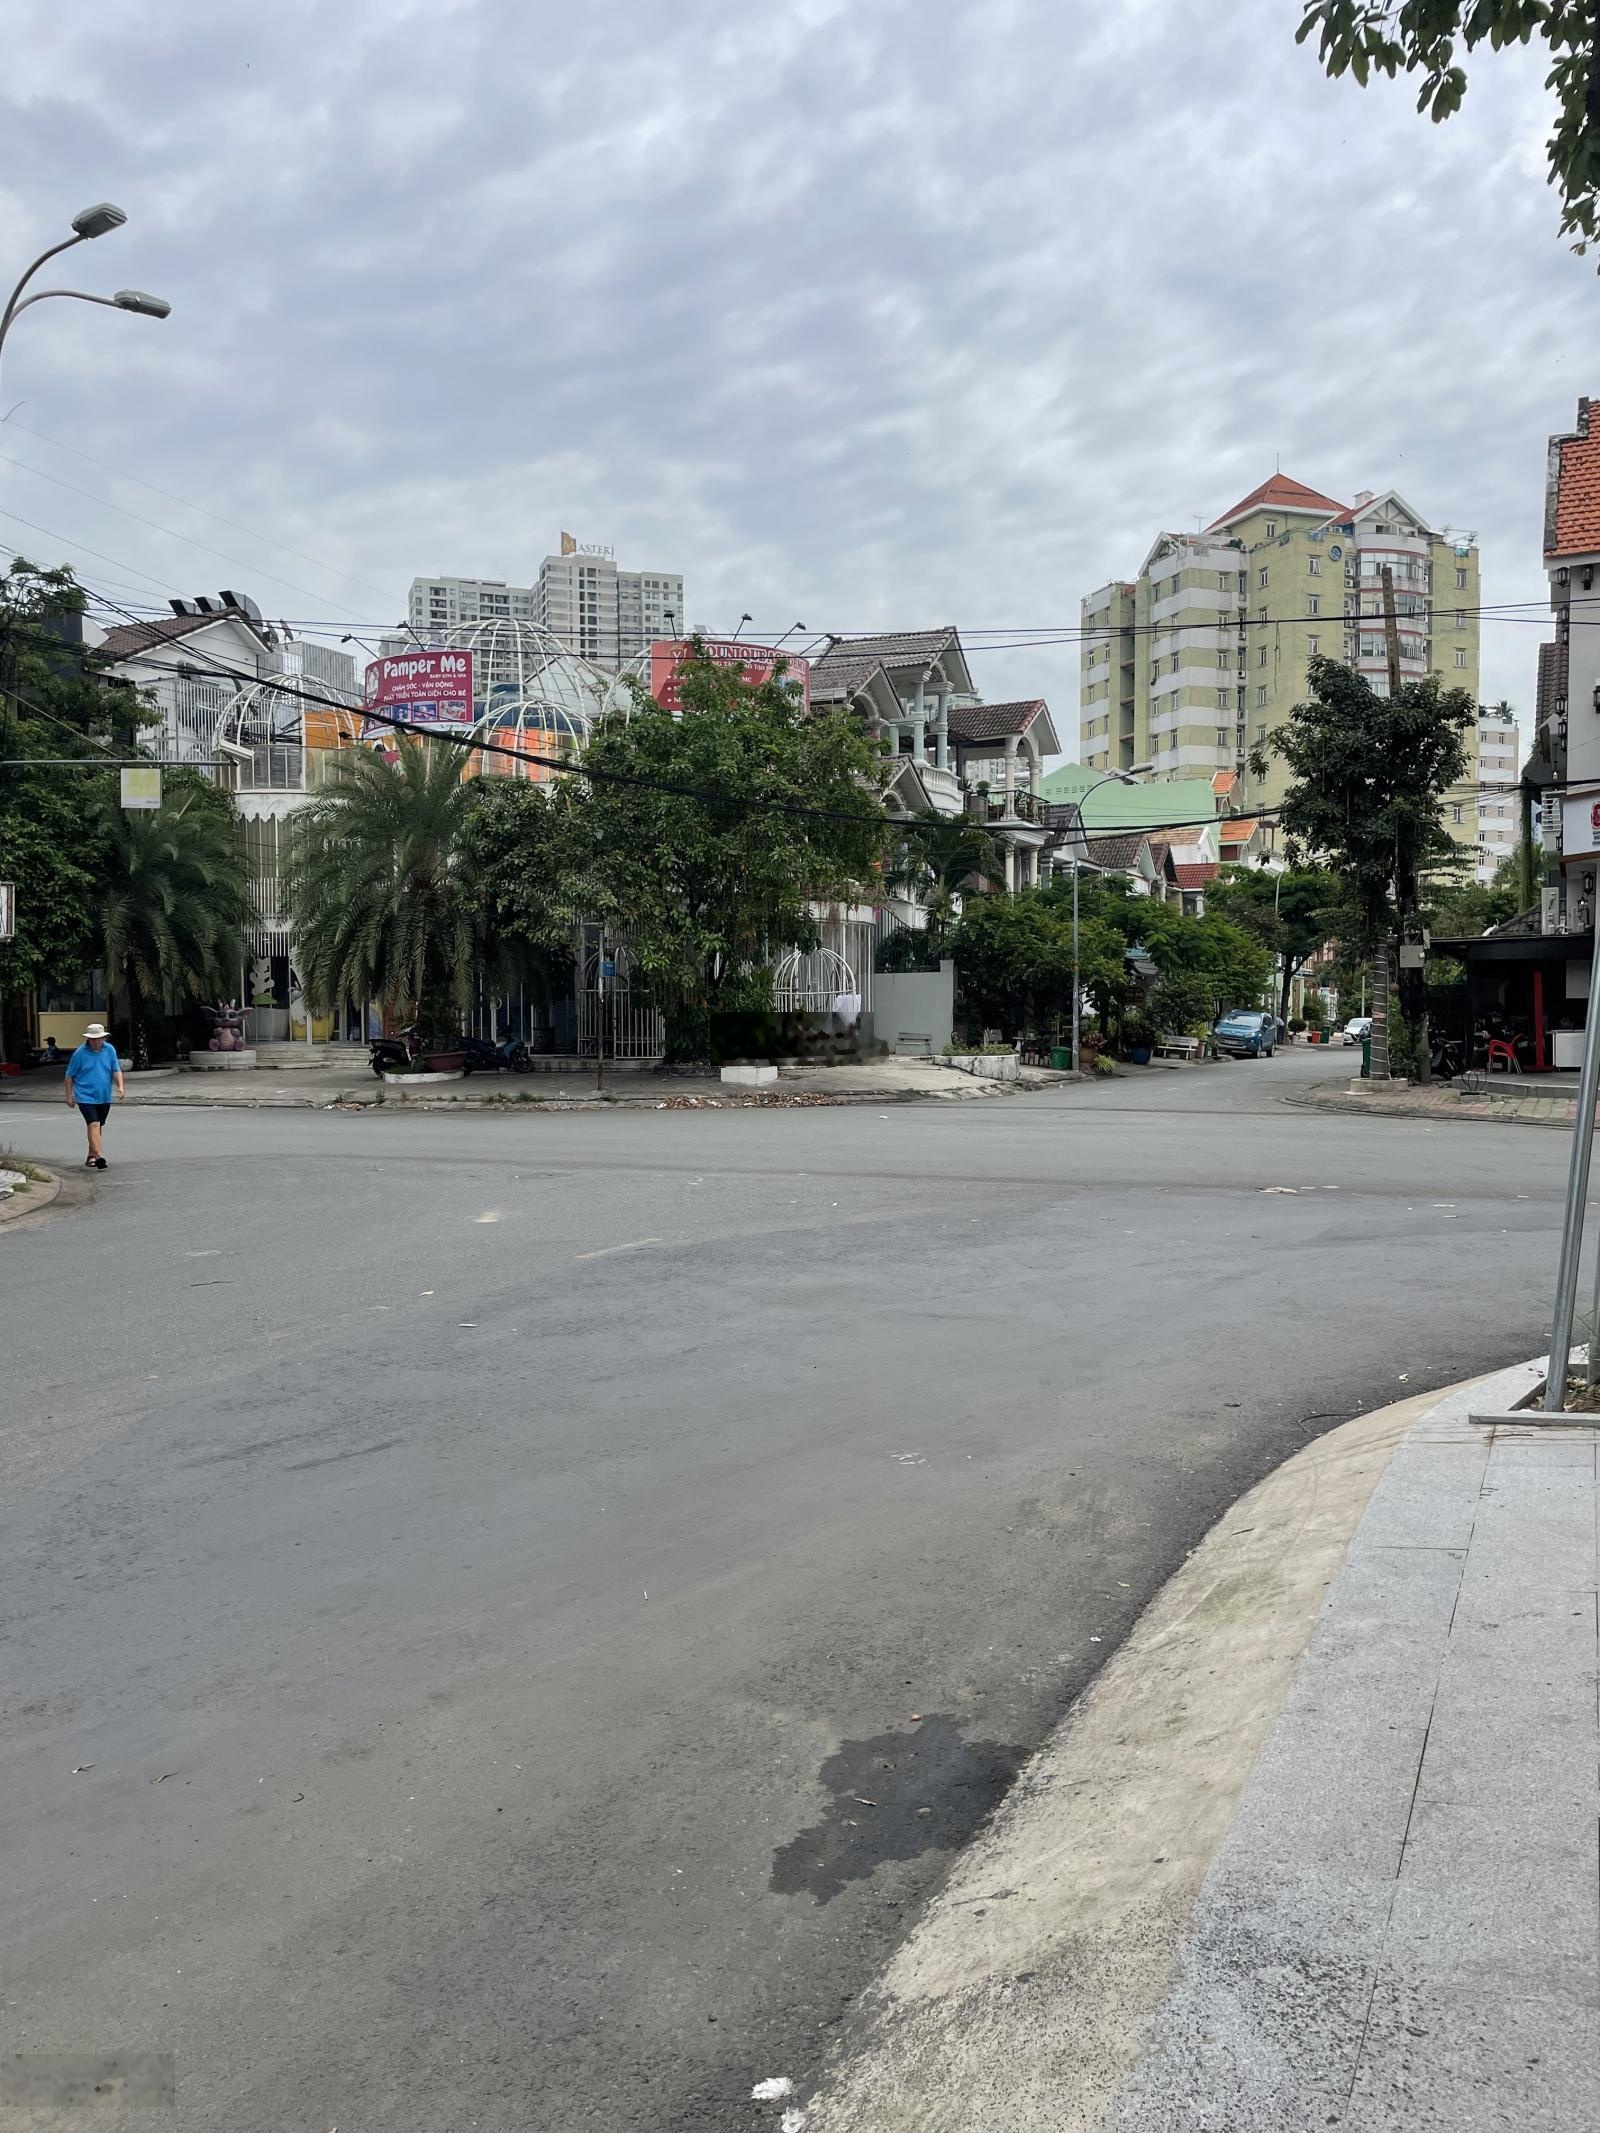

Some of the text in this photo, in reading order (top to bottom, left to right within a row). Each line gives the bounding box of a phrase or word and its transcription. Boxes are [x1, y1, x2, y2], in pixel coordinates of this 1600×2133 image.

[384, 655, 466, 680] Pamper Me
[406, 682, 418, 690] SÓC
[458, 689, 467, 697] BÉ
